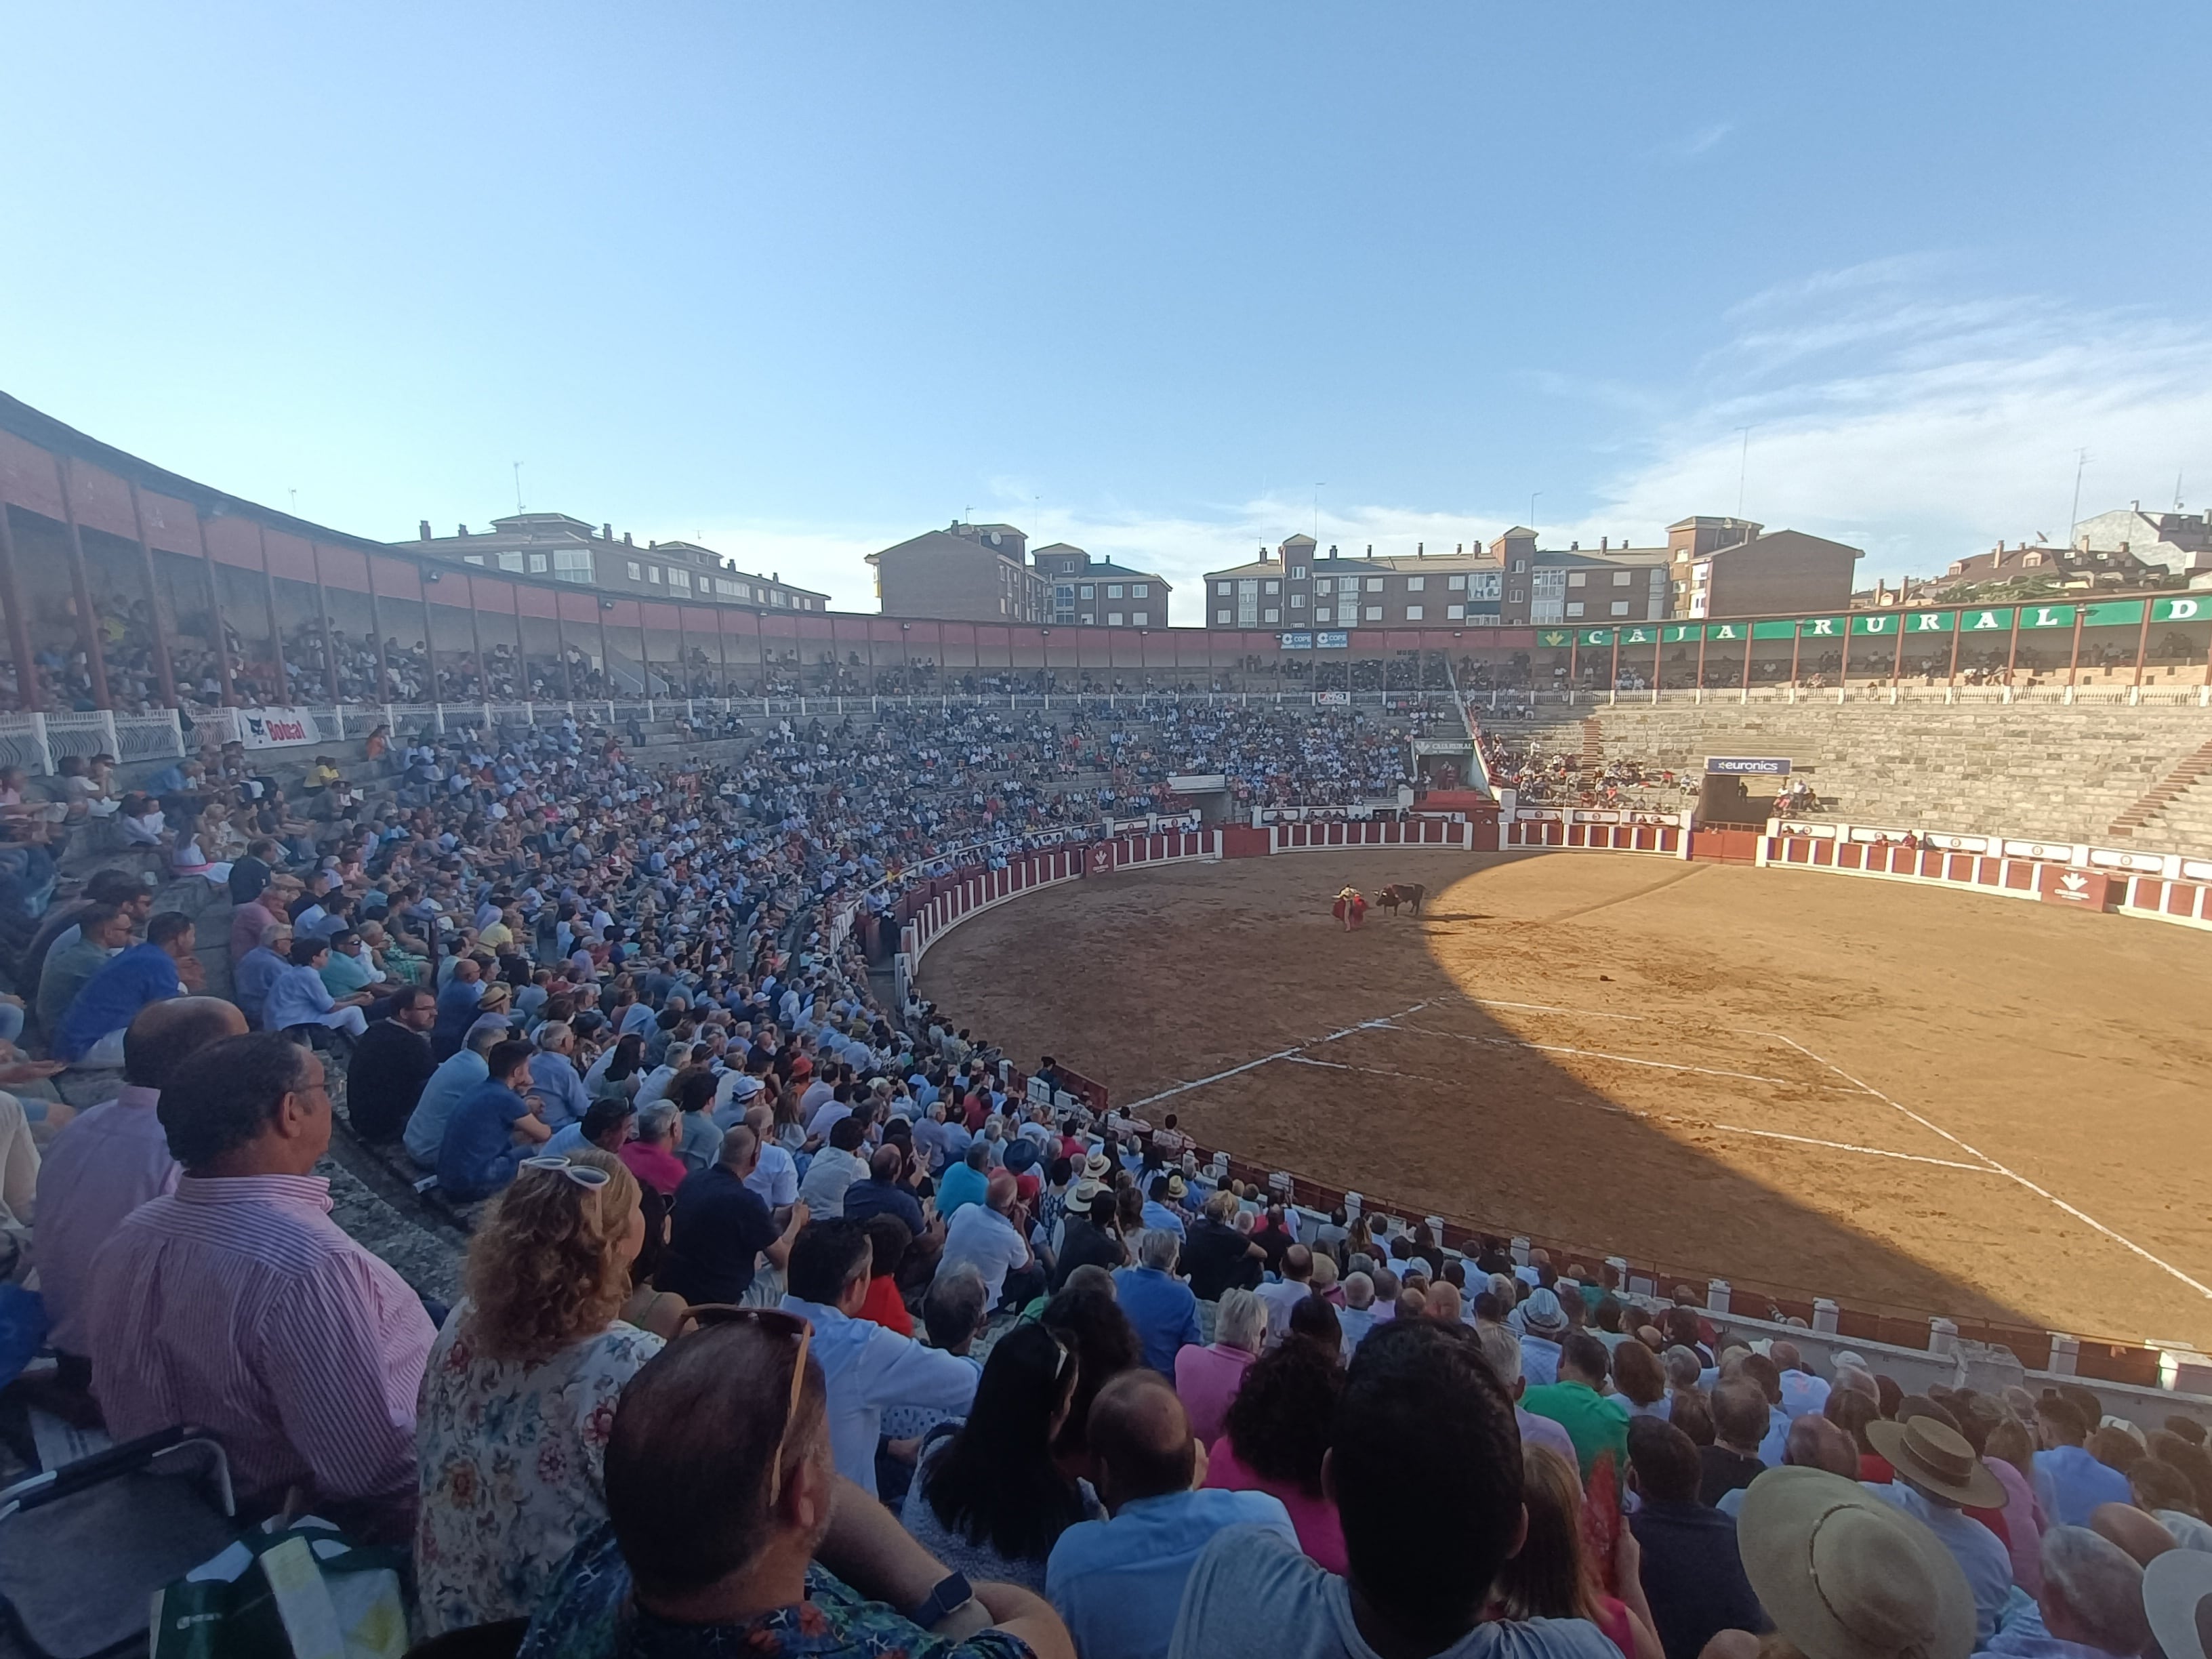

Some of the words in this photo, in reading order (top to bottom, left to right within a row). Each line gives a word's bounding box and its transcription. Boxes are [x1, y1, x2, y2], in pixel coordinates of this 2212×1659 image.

[1588, 625, 1736, 644] CAJA
[1813, 609, 2057, 635] RURAL
[1725, 760, 1778, 771] euronics
